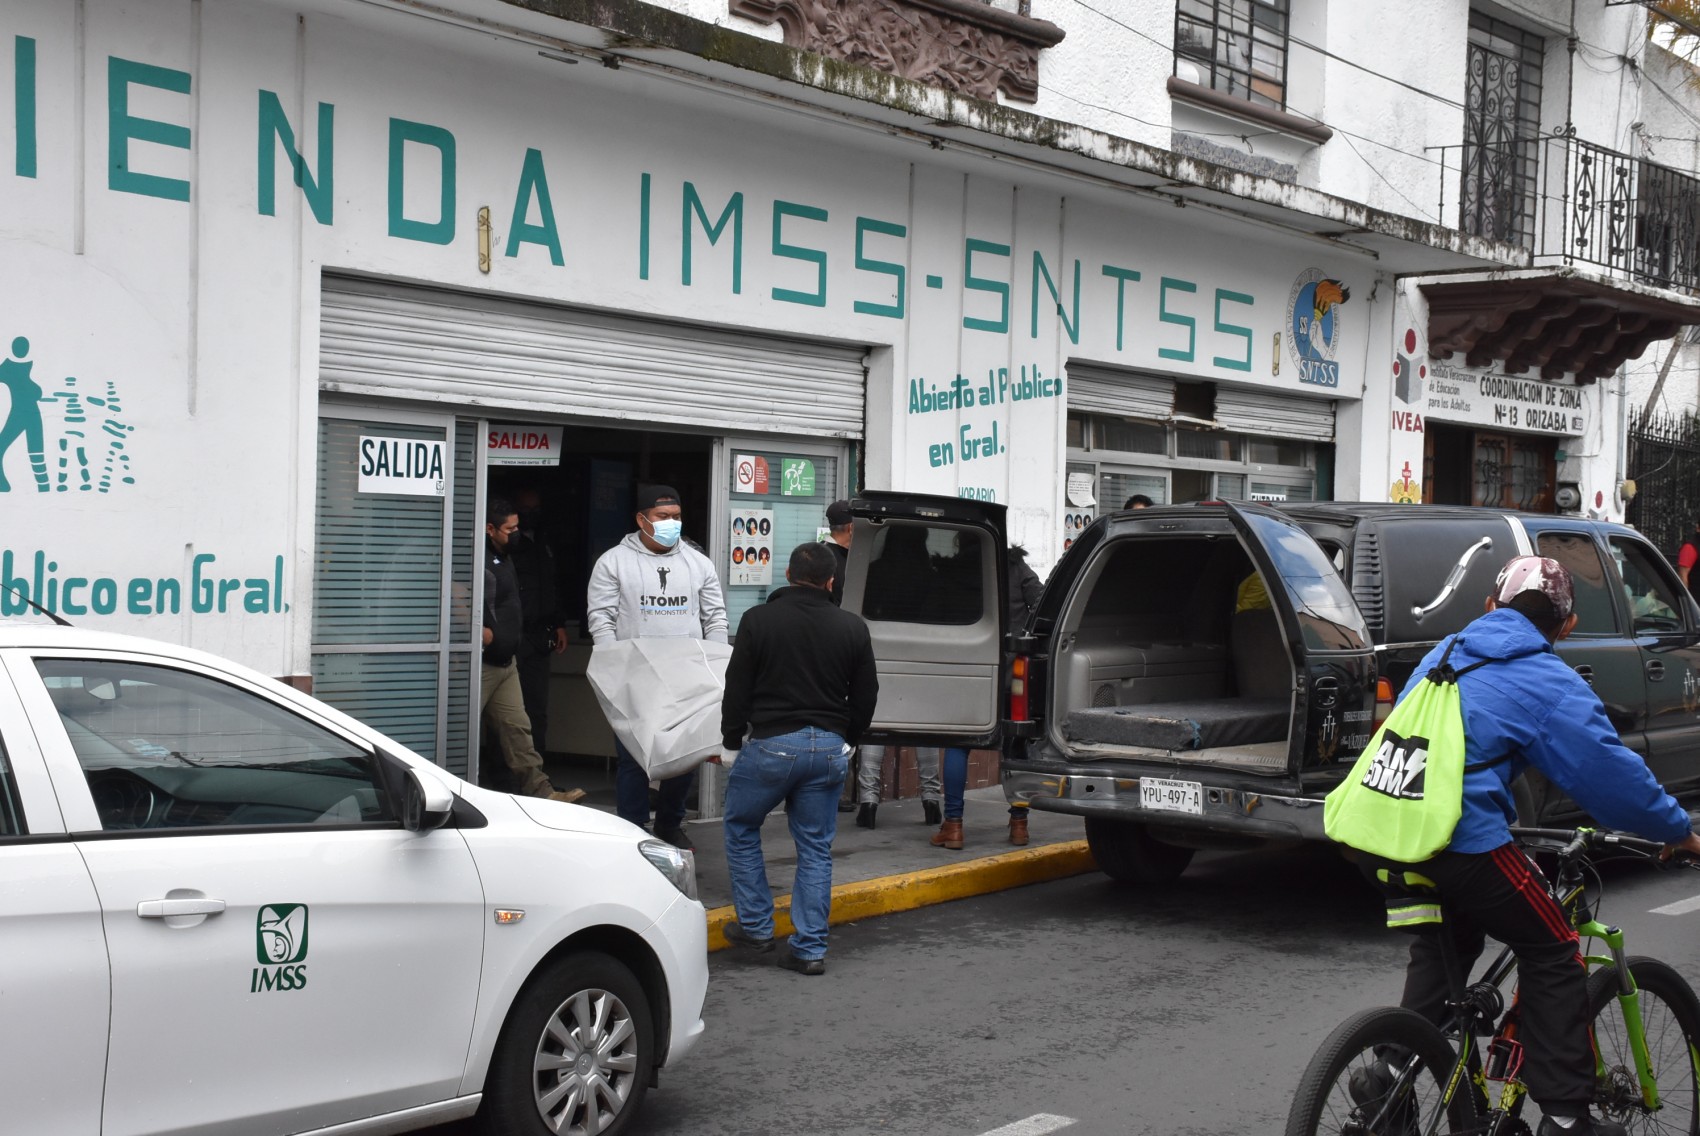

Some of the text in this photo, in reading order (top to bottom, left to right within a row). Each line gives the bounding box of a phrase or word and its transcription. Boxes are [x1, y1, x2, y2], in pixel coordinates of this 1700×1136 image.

[1300, 360, 1336, 385] SNTSS
[909, 374, 975, 414] Abierto
[978, 369, 996, 406] al
[1428, 380, 1435, 392] de
[1480, 376, 1582, 410] COORDINACION DE ZONA
[1450, 398, 1471, 412] Adultos
[1391, 410, 1424, 434] IVEA
[1508, 405, 1518, 426] 13
[1525, 408, 1567, 432] ORIZABA
[487, 431, 550, 450] SALIDA
[928, 420, 1005, 468] en Gral.
[361, 438, 444, 480] SALIDA
[127, 577, 181, 615] en
[191, 553, 290, 615] Gral.
[640, 595, 688, 607] STOMP
[1142, 786, 1200, 807] YPU-497-A
[250, 964, 307, 993] IMSS
